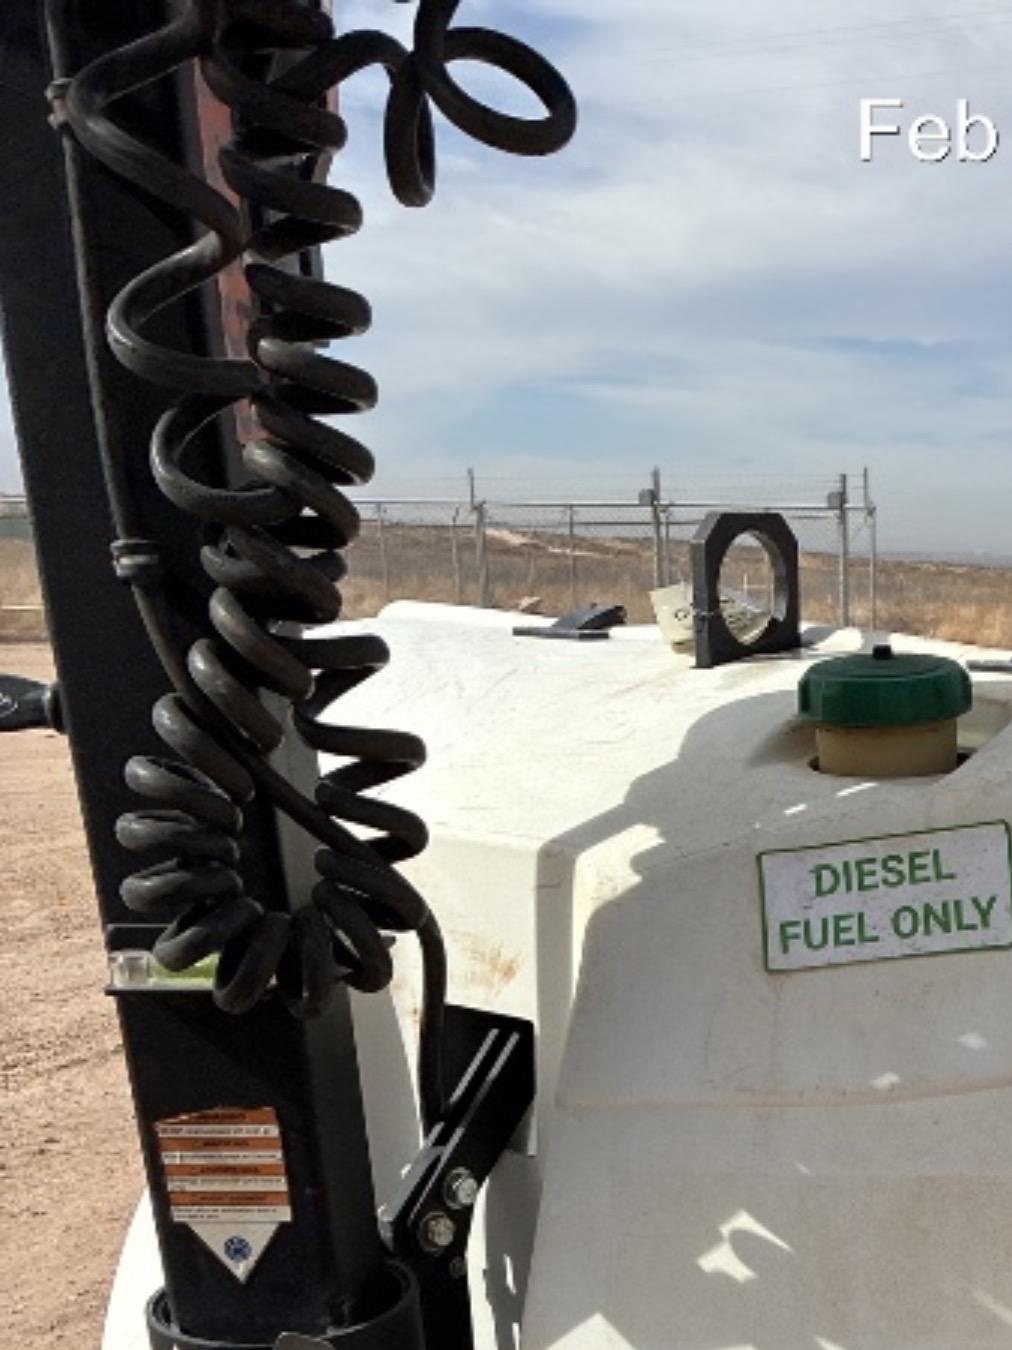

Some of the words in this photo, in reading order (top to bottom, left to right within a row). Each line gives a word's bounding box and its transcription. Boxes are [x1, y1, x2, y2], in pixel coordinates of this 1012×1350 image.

[811, 849, 957, 897] DIESEL
[779, 911, 880, 954] FUEL
[891, 896, 997, 940] ONLY
